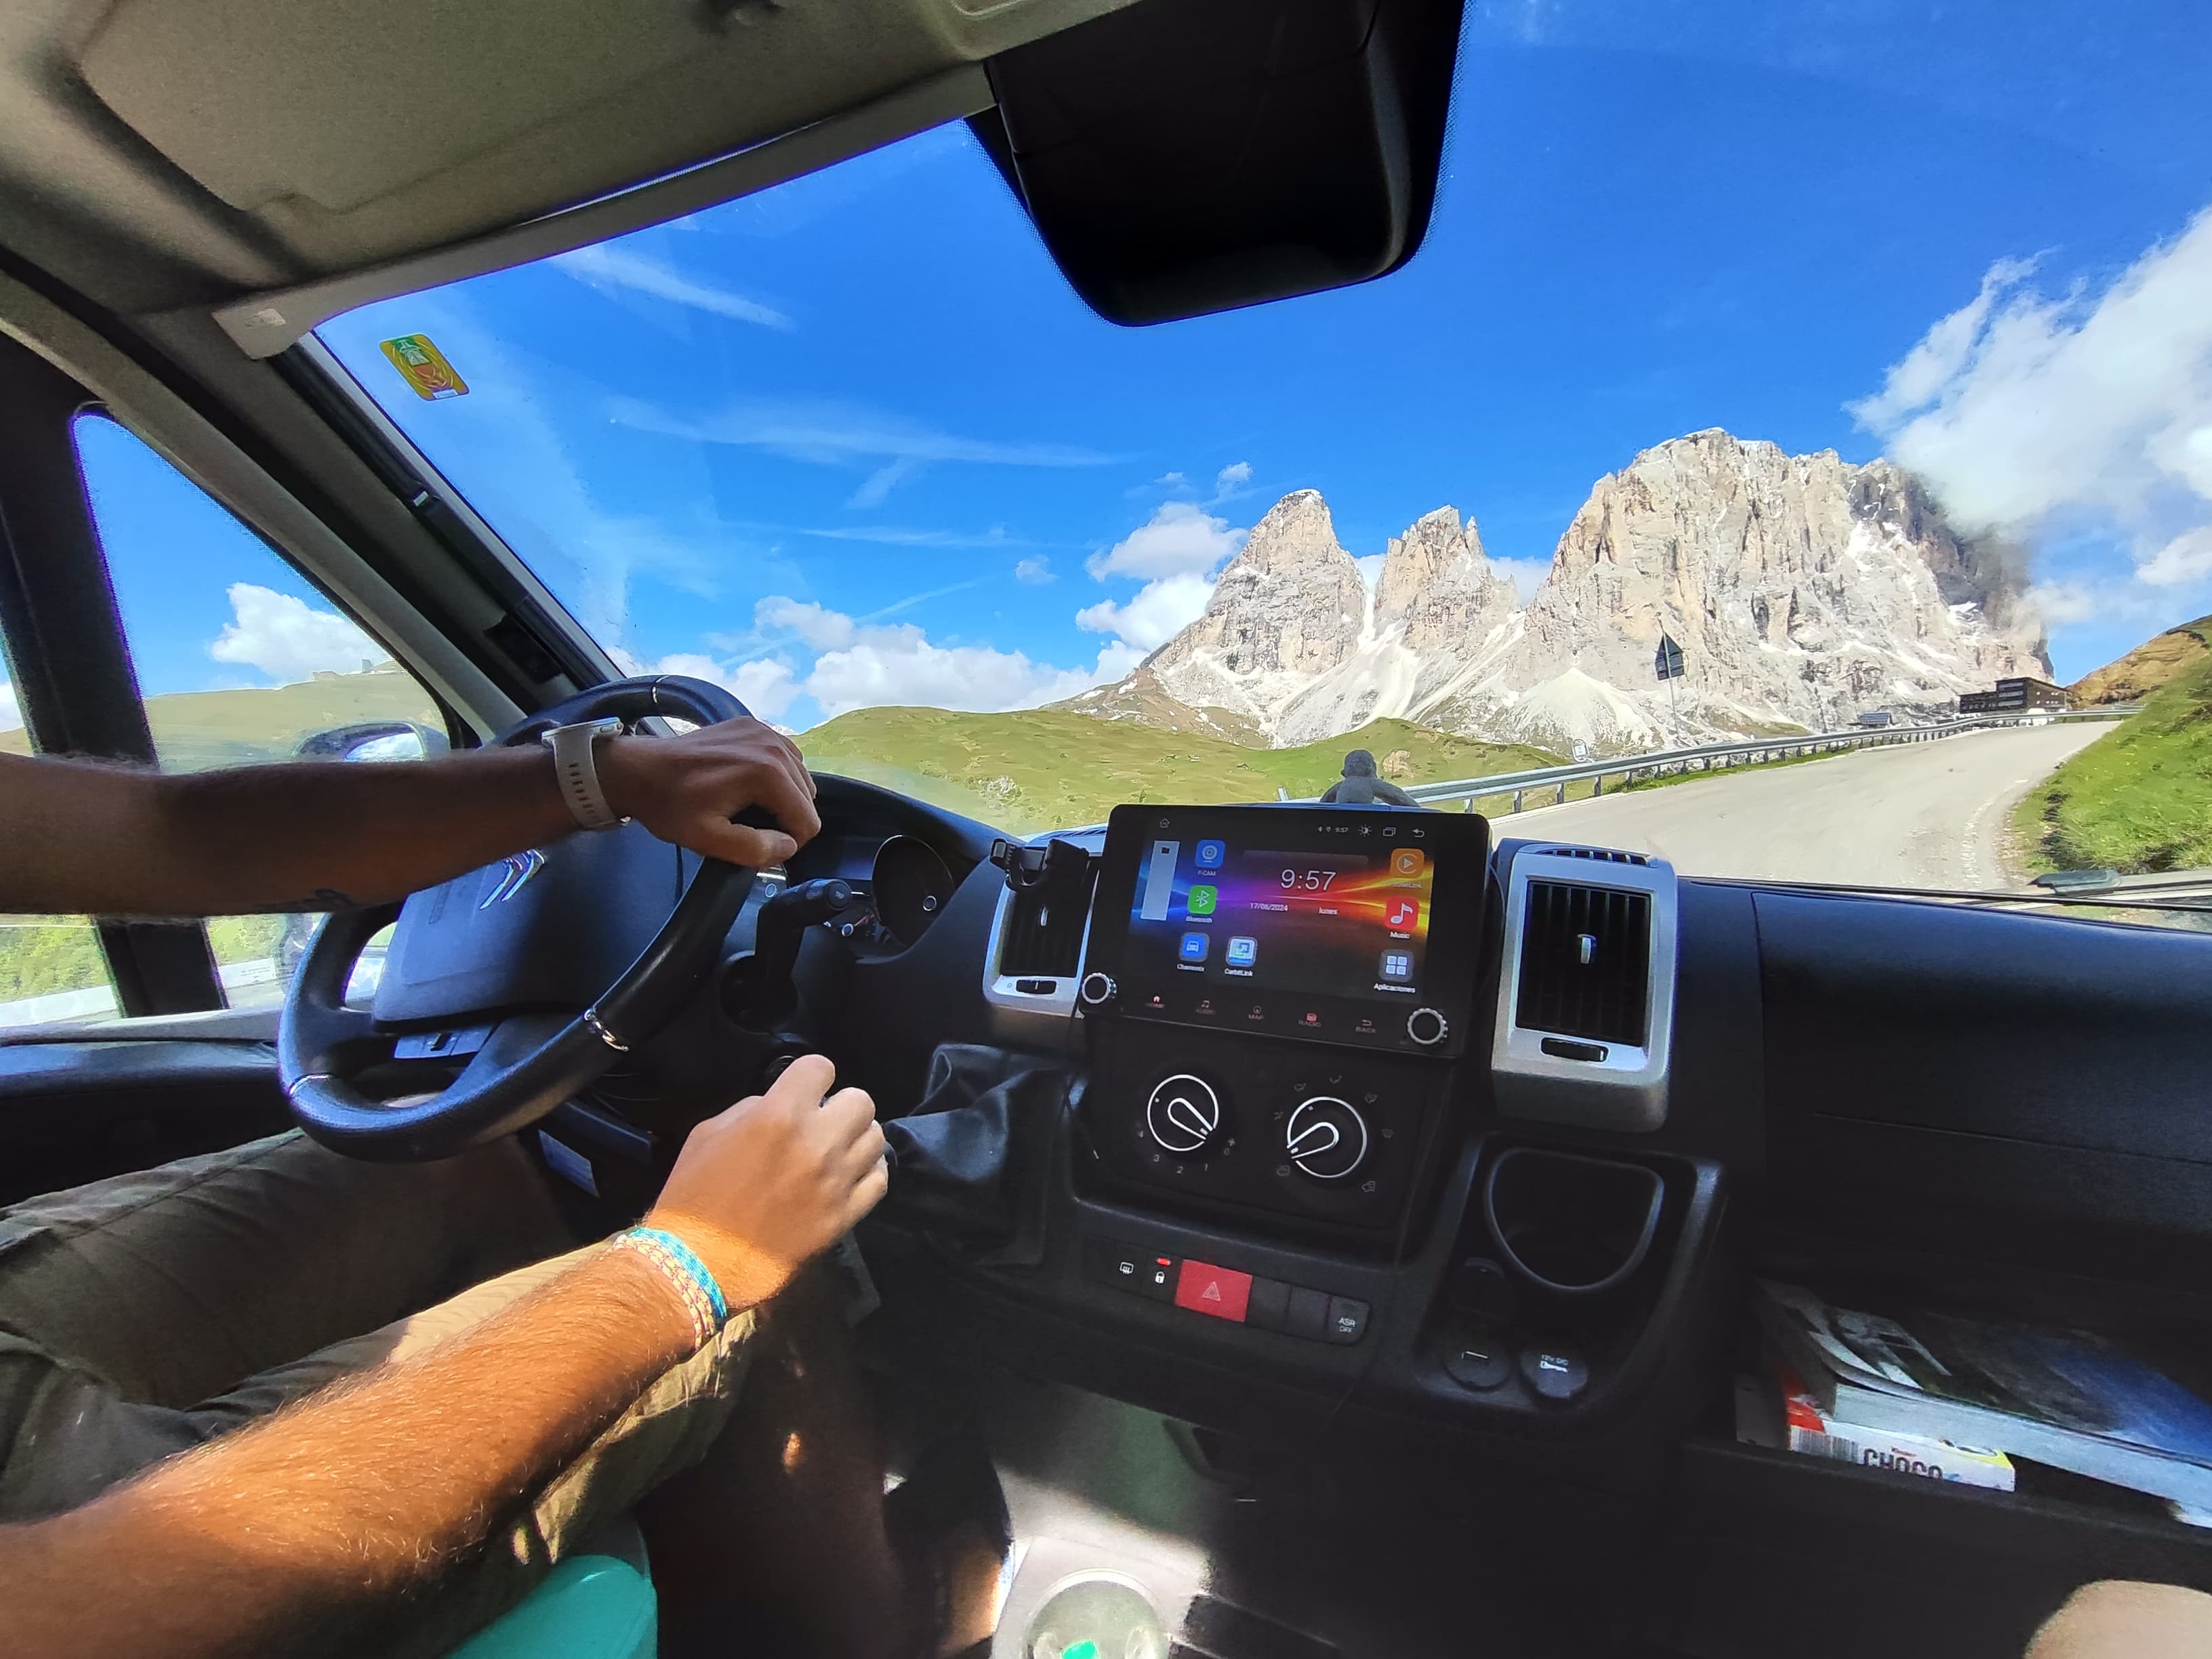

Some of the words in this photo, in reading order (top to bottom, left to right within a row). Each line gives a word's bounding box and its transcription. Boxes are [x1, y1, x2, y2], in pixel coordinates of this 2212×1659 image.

[1280, 869, 1336, 890] 9:57
[1250, 903, 1288, 912] 17/06/2024
[1390, 931, 1410, 939] Music
[1374, 983, 1416, 994] Aplicaciones
[1298, 1019, 1322, 1027] RADIO
[1355, 1026, 1376, 1034] BACK
[1153, 1154, 1160, 1162] 3
[1176, 1166, 1184, 1174] 2
